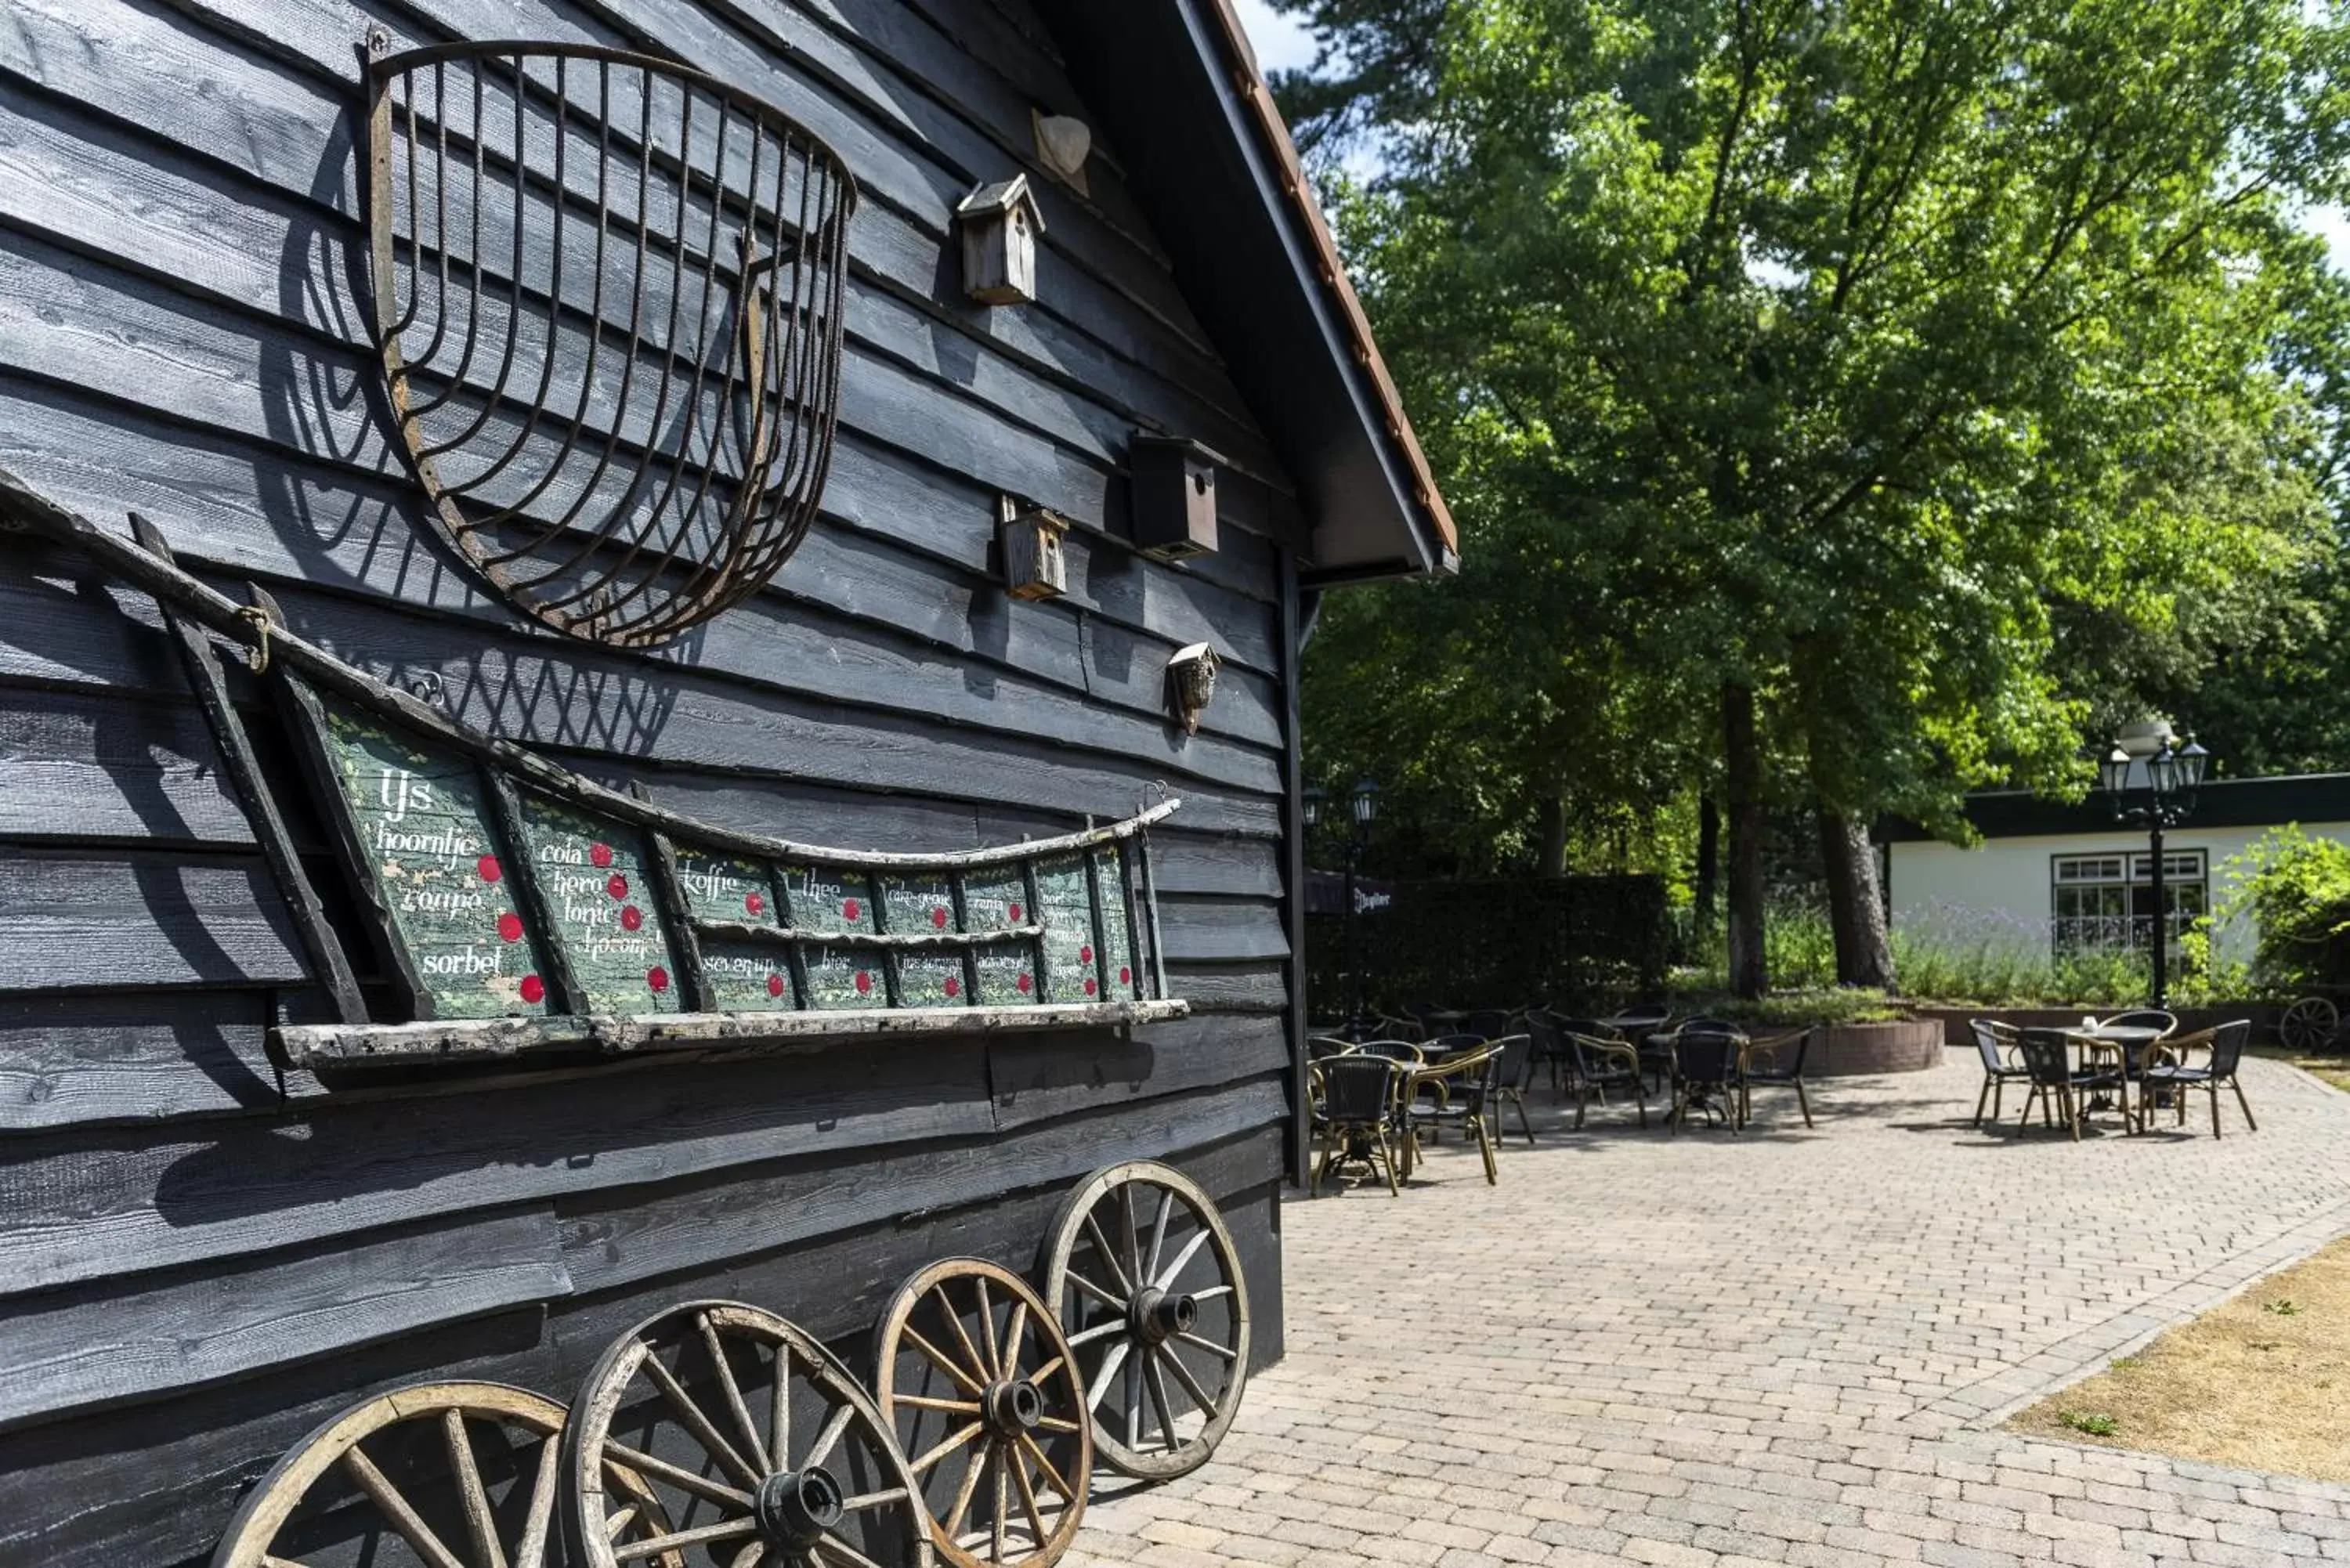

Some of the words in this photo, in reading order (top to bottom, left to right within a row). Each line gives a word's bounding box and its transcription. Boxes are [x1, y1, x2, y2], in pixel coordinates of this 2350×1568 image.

[375, 820, 479, 871] hoorntje
[541, 837, 582, 864] cola
[552, 867, 602, 896] hero
[684, 860, 738, 903] koffie
[803, 867, 841, 902] thee
[564, 896, 613, 927] tonic
[423, 945, 502, 974] sorbet
[821, 945, 851, 970] bier
